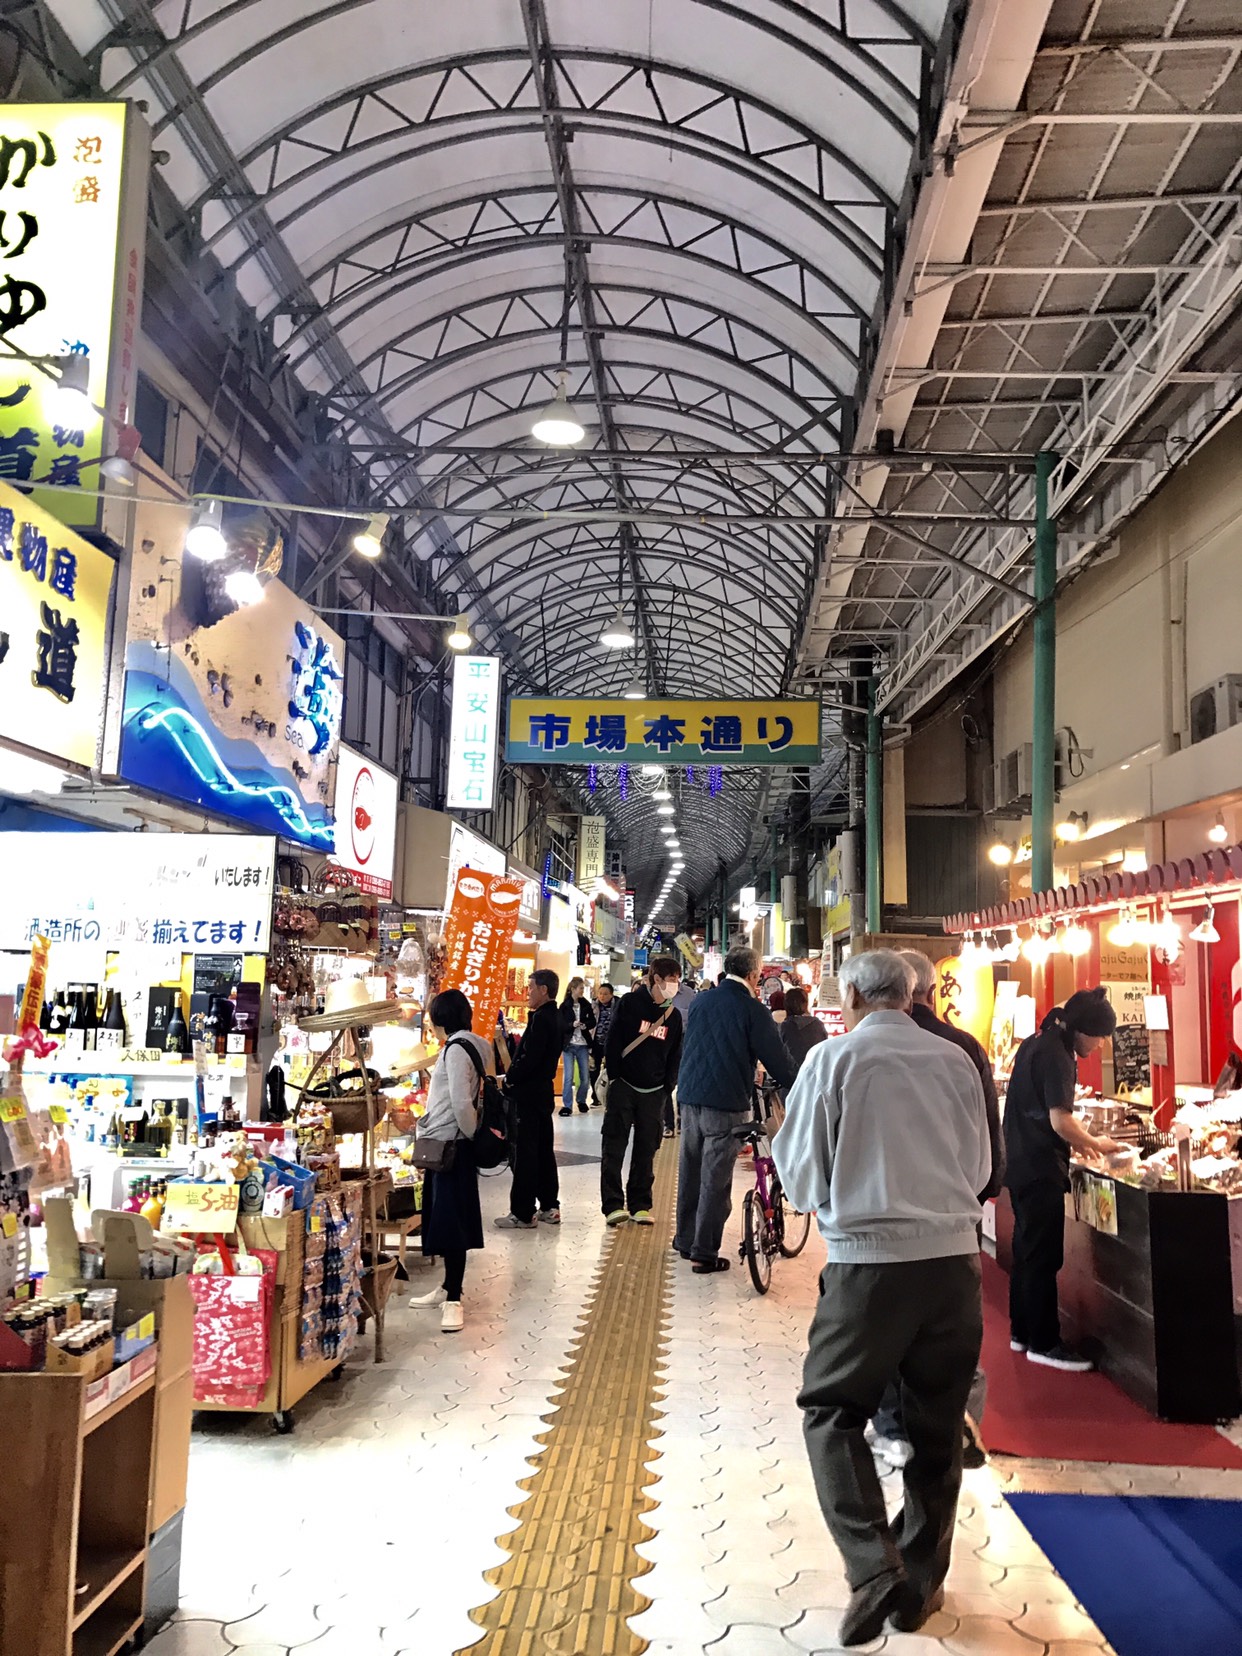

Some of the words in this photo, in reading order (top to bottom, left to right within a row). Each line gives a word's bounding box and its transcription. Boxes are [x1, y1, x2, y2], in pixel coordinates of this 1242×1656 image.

[462, 662, 490, 801] 平安山宝石
[528, 713, 794, 753] 市場本通り
[585, 820, 600, 877] 泡盛専門
[478, 928, 505, 1022] マーミヤかまぼこ
[638, 1020, 667, 1040] MAVEL
